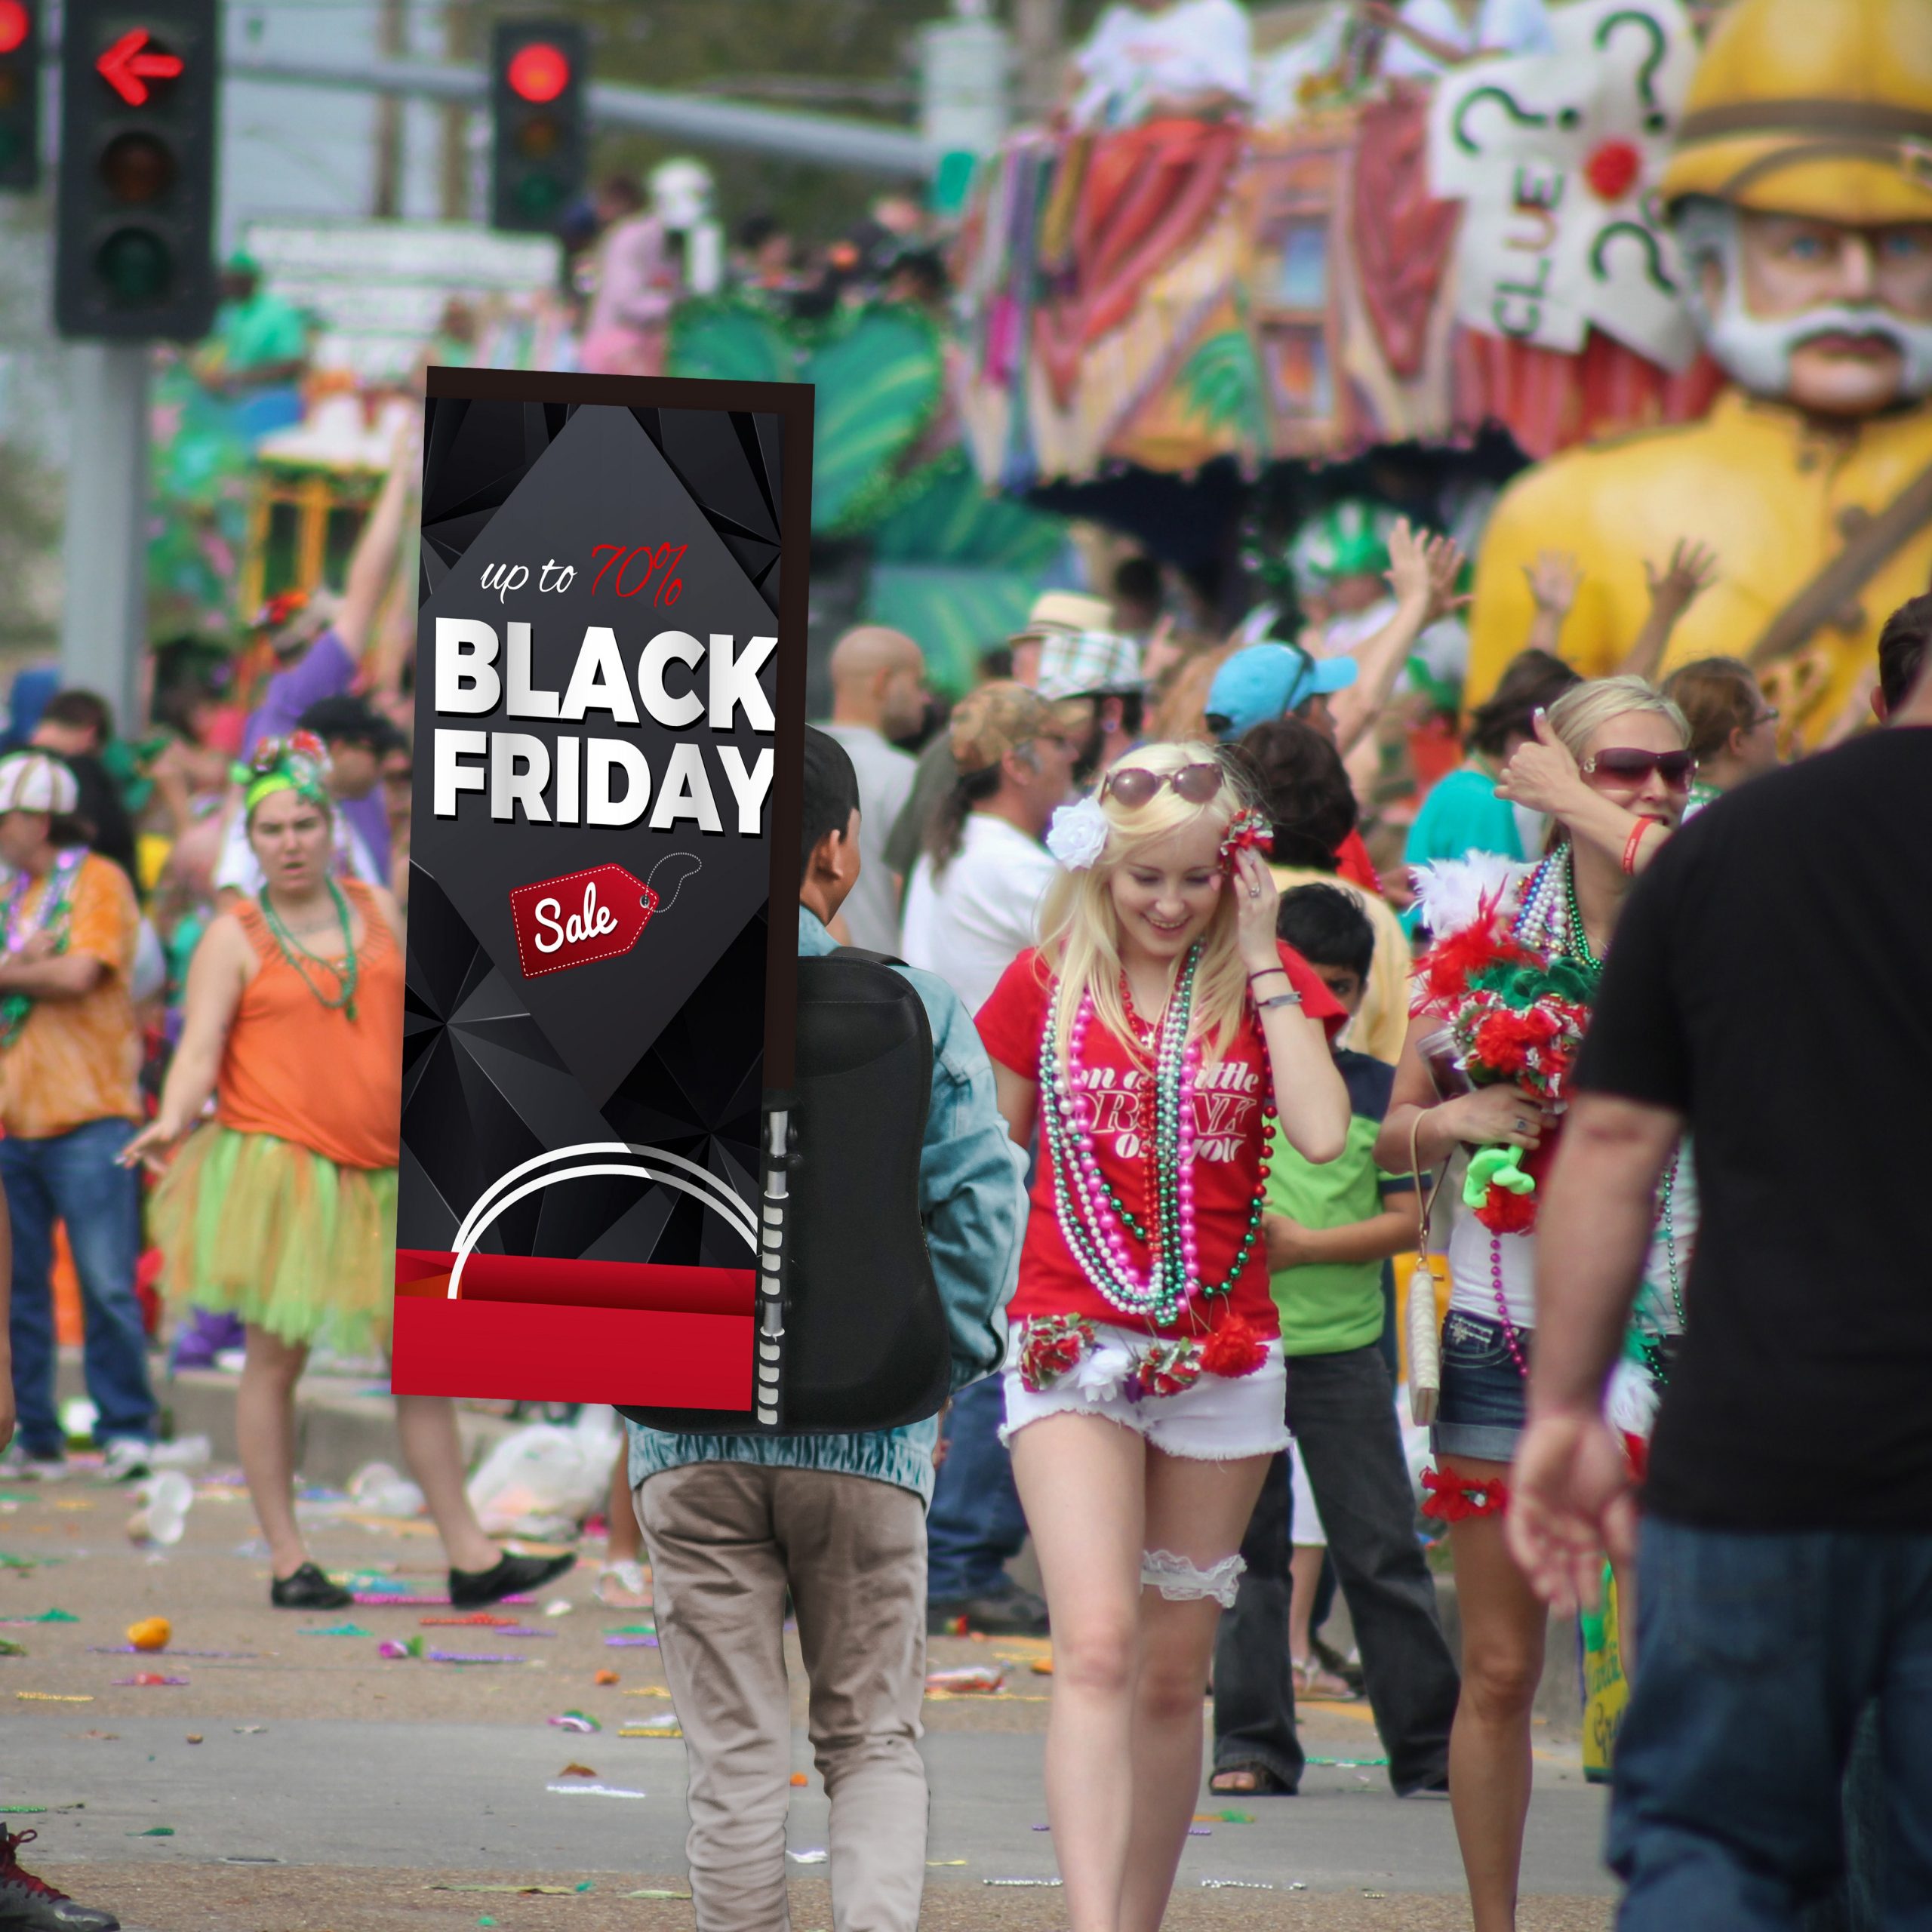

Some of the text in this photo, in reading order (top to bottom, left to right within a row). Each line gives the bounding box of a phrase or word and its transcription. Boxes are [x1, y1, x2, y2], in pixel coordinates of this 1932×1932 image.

[1492, 165, 1564, 339] CLUE
[480, 541, 688, 608] up to 70%
[435, 617, 779, 732] BLACK
[433, 728, 775, 835] FRIDAY
[534, 881, 619, 953] Sale
[1072, 1091, 1257, 1137] RNK
[1193, 1062, 1259, 1094] ittle
